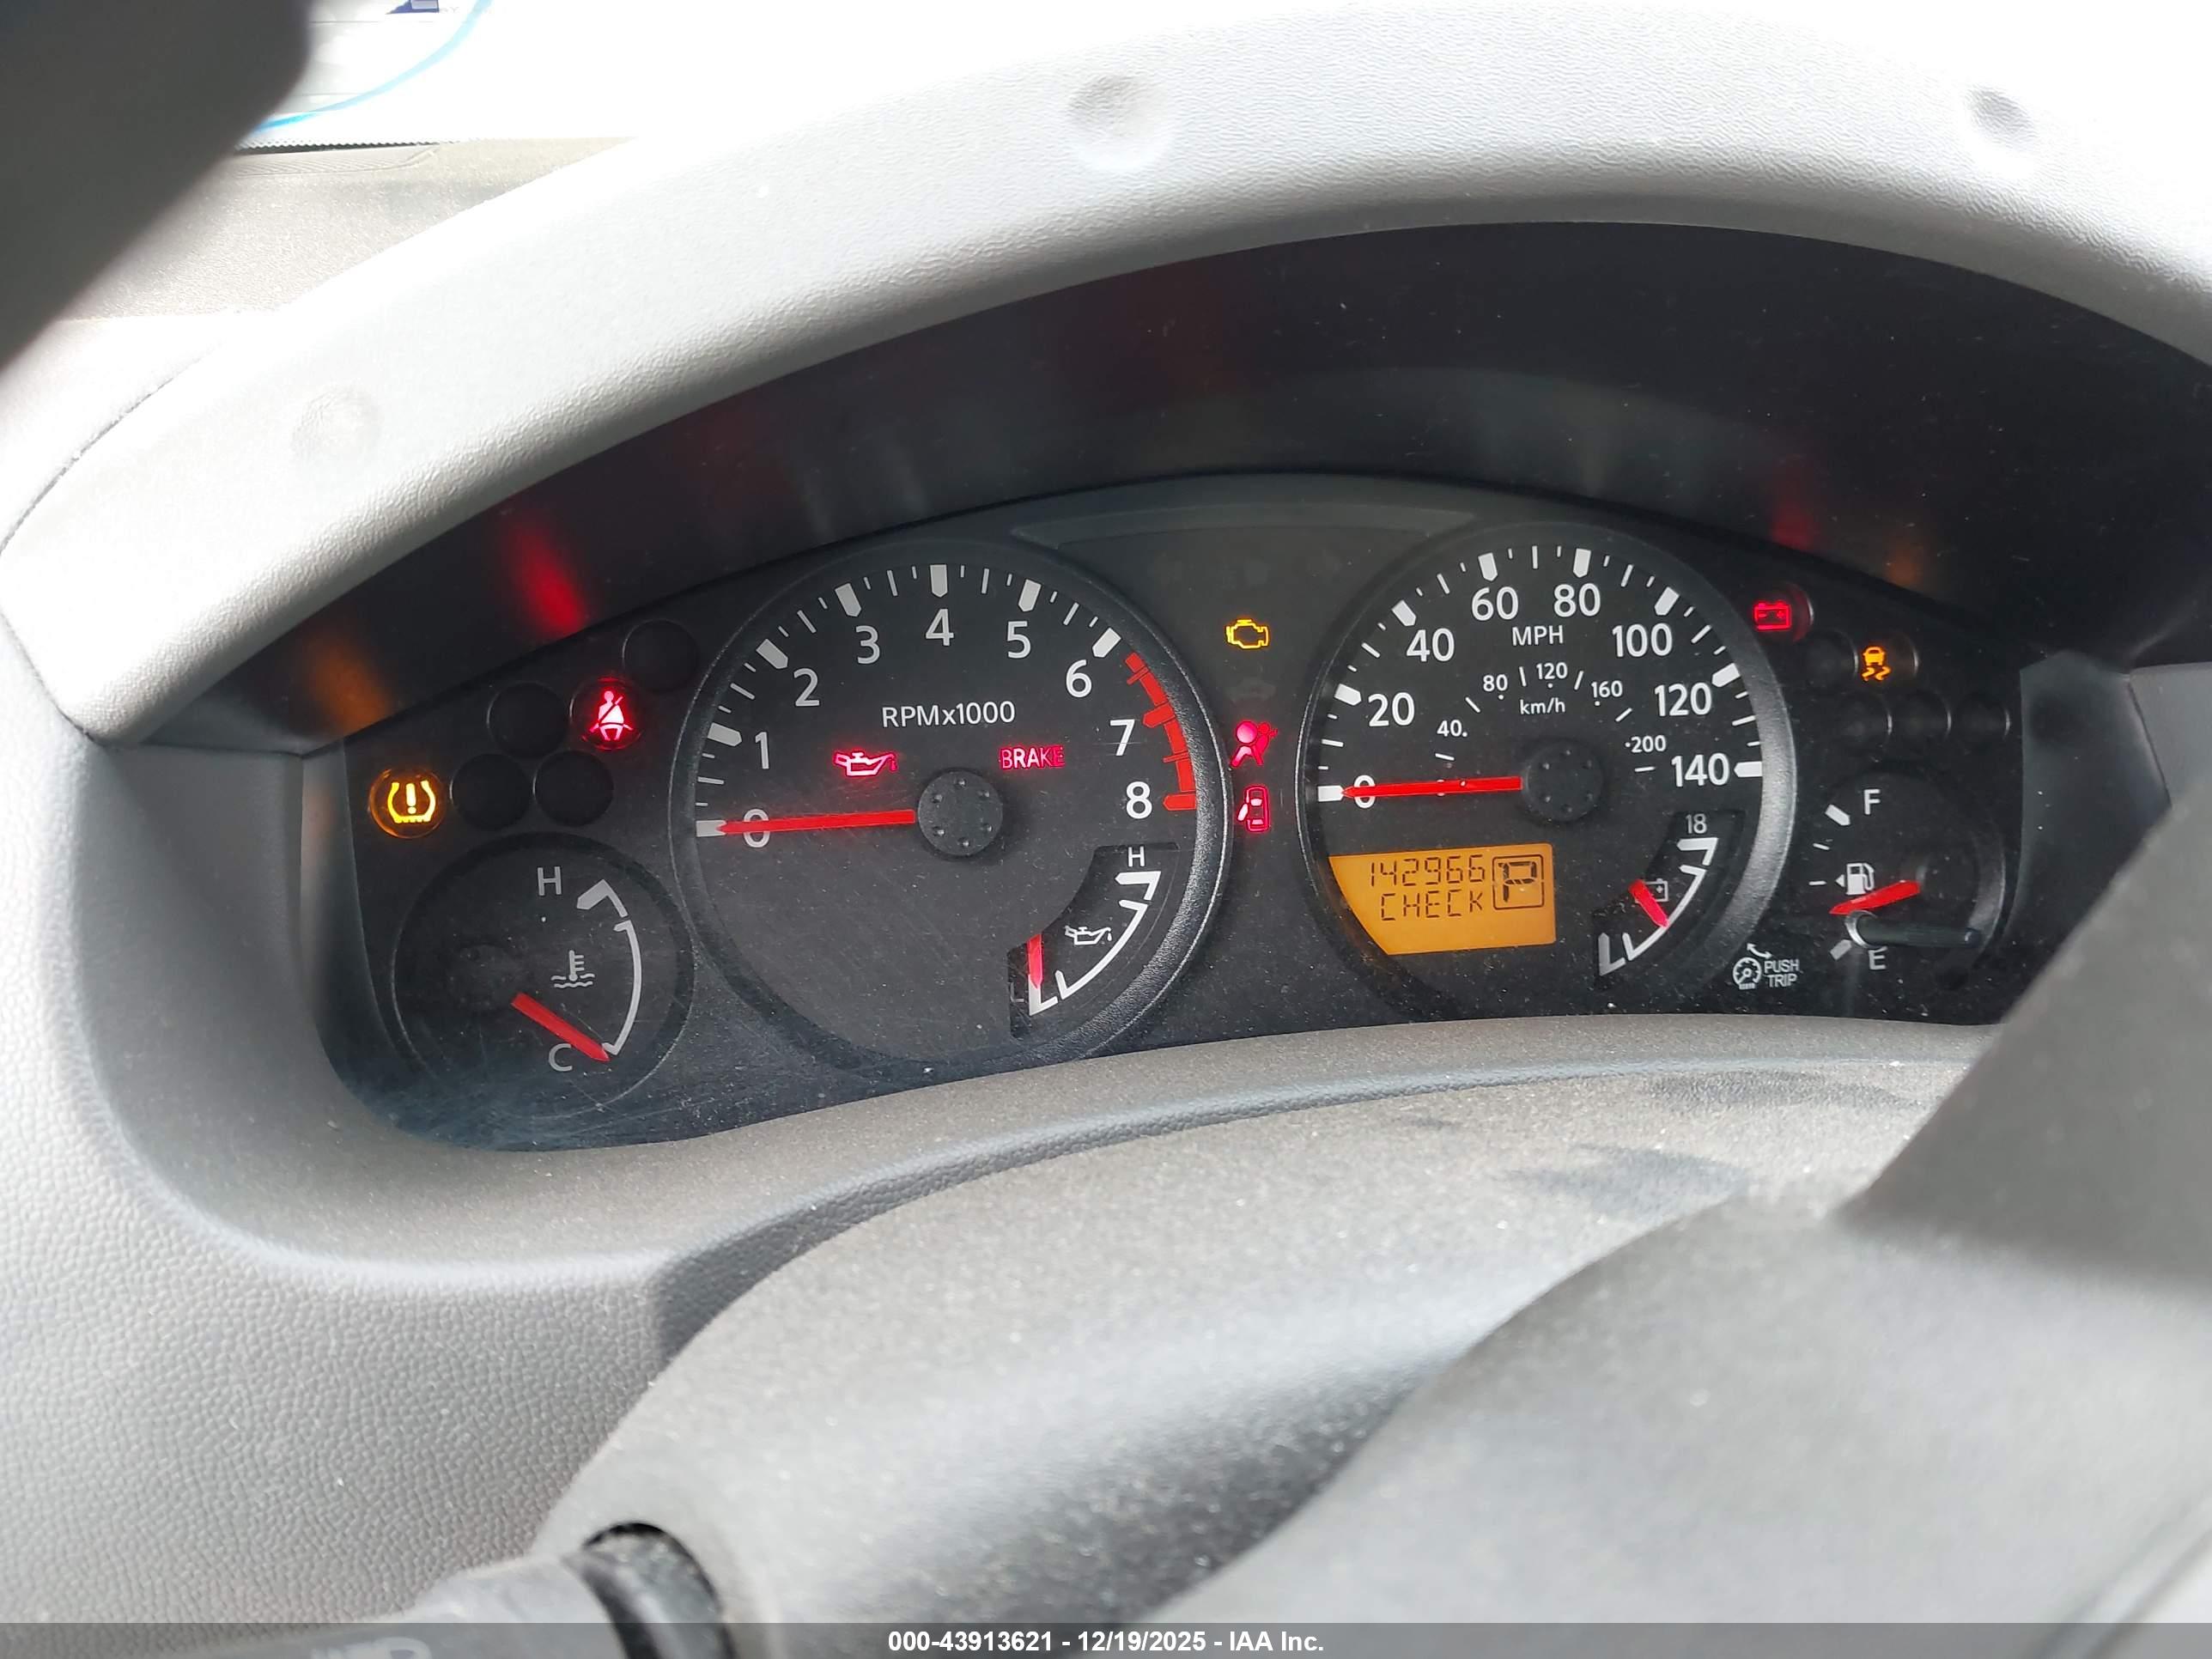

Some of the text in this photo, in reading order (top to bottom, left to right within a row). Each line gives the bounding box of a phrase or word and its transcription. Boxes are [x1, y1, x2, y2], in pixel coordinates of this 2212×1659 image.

[1472, 586, 1518, 620] 60
[1554, 583, 1600, 617] 80
[926, 609, 953, 646] 4
[1007, 621, 1030, 658] 5
[1513, 625, 1563, 646] MPH
[1613, 623, 1672, 657] 100
[856, 626, 879, 664] 3
[1407, 629, 1454, 661] 40
[1066, 659, 1091, 697] 6
[1484, 675, 1507, 691] 80
[1537, 662, 1567, 679] 120
[794, 668, 819, 706] 2
[1592, 681, 1622, 697] 160
[1655, 683, 1711, 716] 120
[883, 701, 1014, 726] RPMx1000
[1369, 692, 1414, 726] 20
[1521, 698, 1565, 714] km/h
[756, 732, 769, 769] 1
[1110, 720, 1134, 756] 7
[1632, 735, 1666, 752] 200
[1002, 747, 1064, 768] BRAKE
[1672, 753, 1729, 787] 140
[1127, 781, 1152, 818] 8
[1354, 775, 1375, 808] 0
[1864, 789, 1880, 814] F
[744, 809, 769, 848] 0
[1687, 814, 1706, 833] 18
[1128, 847, 1145, 866] H
[1370, 854, 1485, 887] 142966
[538, 866, 561, 896] H
[1498, 860, 1537, 902] P
[1381, 889, 1484, 921] CHECK
[1764, 958, 1800, 974] PUSH
[1869, 946, 1887, 969] E
[1767, 974, 1796, 987] TRIP
[549, 1043, 572, 1071] C
